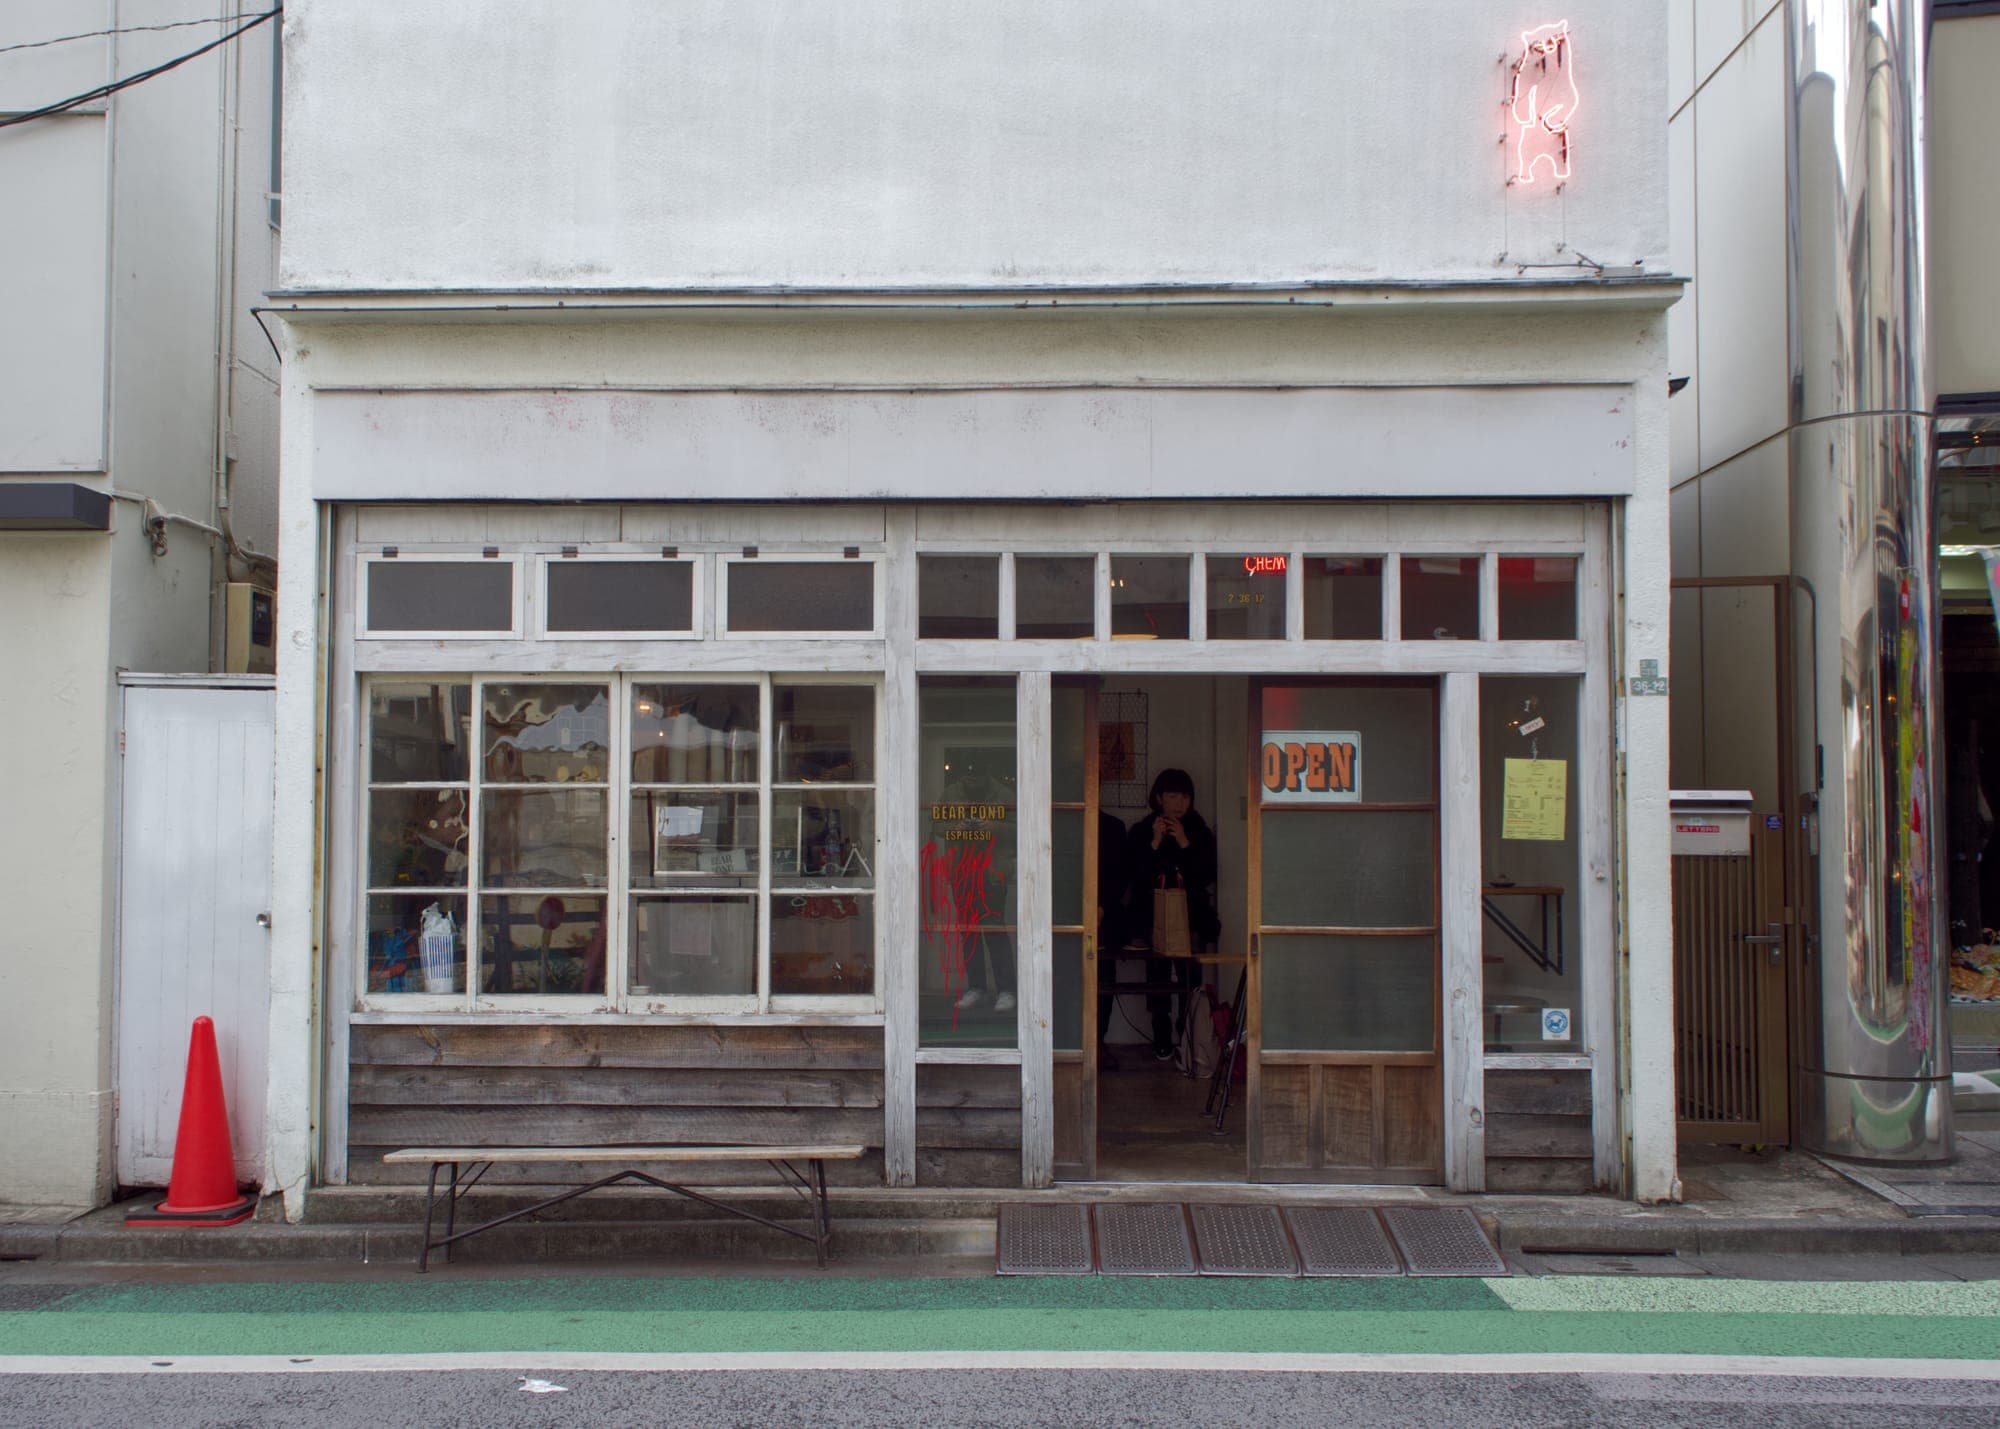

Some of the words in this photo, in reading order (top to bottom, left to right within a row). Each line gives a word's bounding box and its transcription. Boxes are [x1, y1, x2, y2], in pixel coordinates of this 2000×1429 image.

[1263, 742, 1355, 792] OPEN
[932, 805, 965, 819] BEAR
[970, 805, 1005, 819] POND
[945, 830, 991, 840] ESPRESSO
